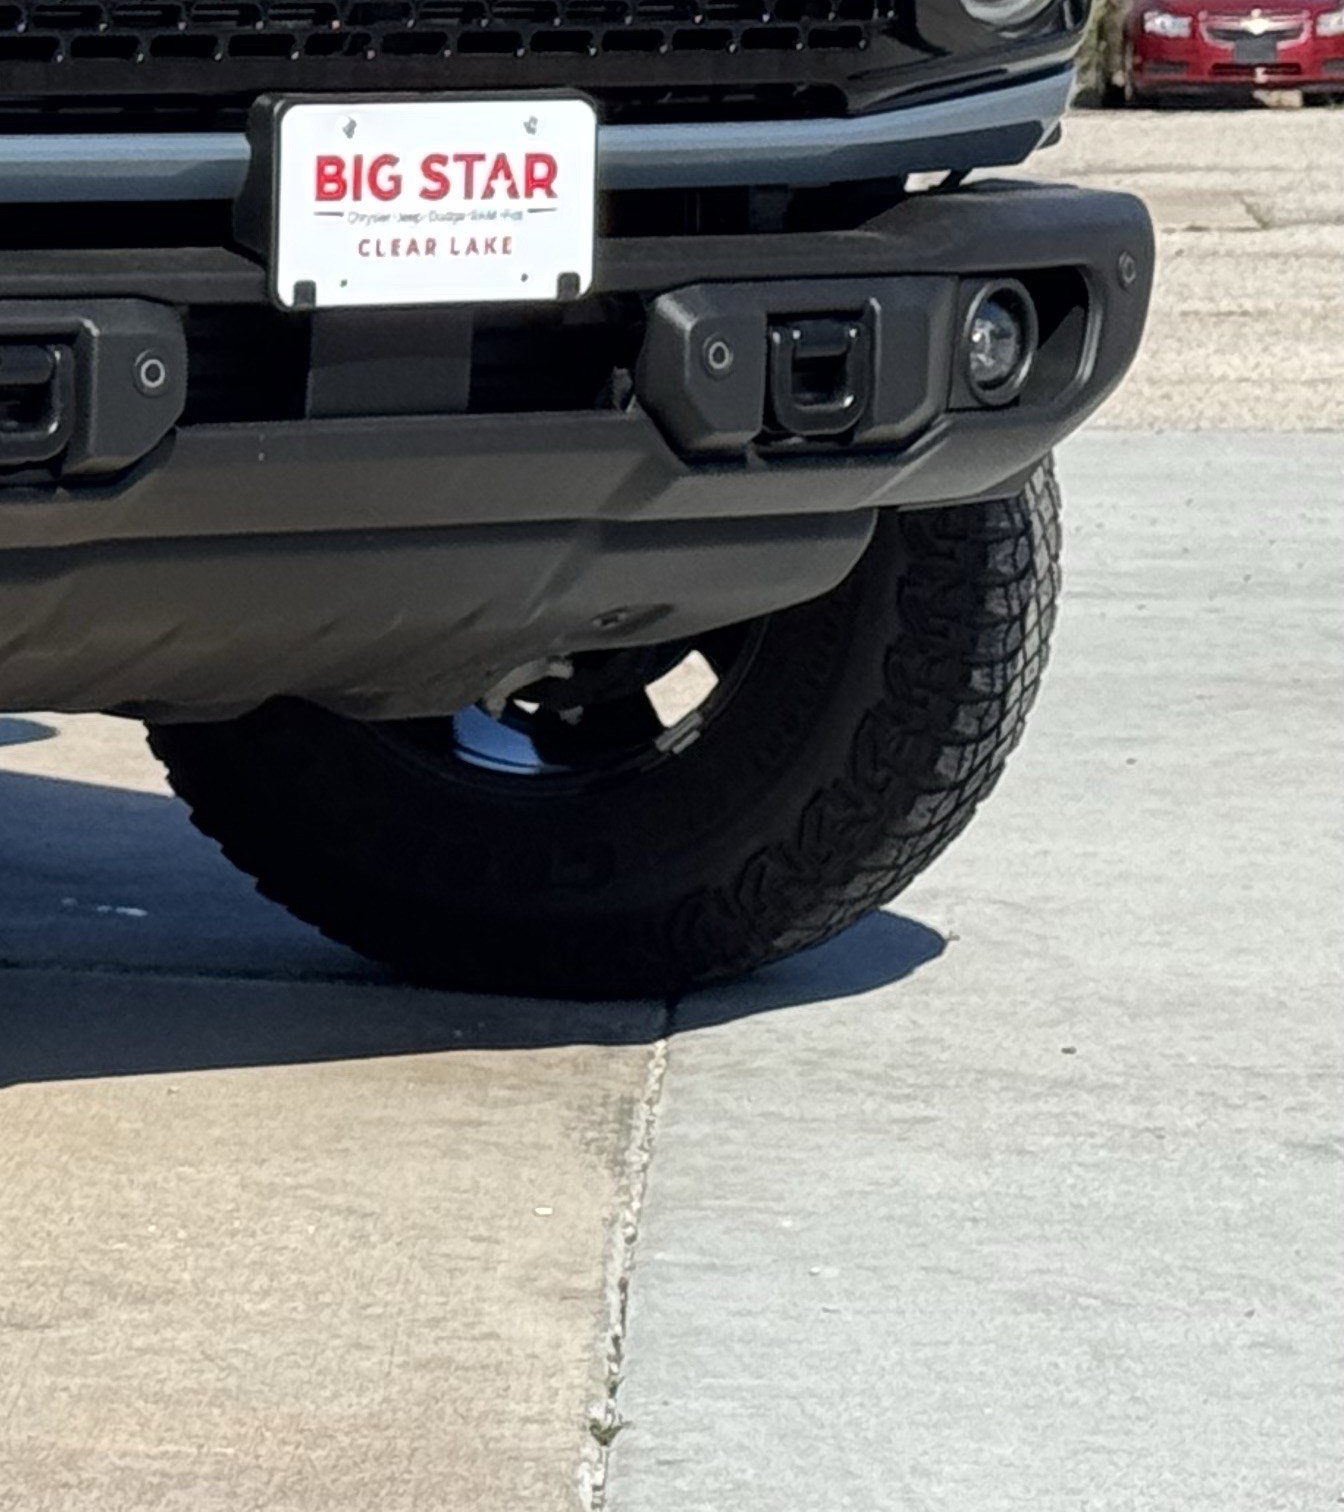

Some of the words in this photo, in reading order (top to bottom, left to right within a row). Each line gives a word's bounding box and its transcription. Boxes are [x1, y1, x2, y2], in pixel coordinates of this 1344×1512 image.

[314, 153, 402, 202] BIG
[419, 152, 559, 201] STAR
[358, 237, 437, 258] CLEAR
[450, 235, 513, 255] LAKE
